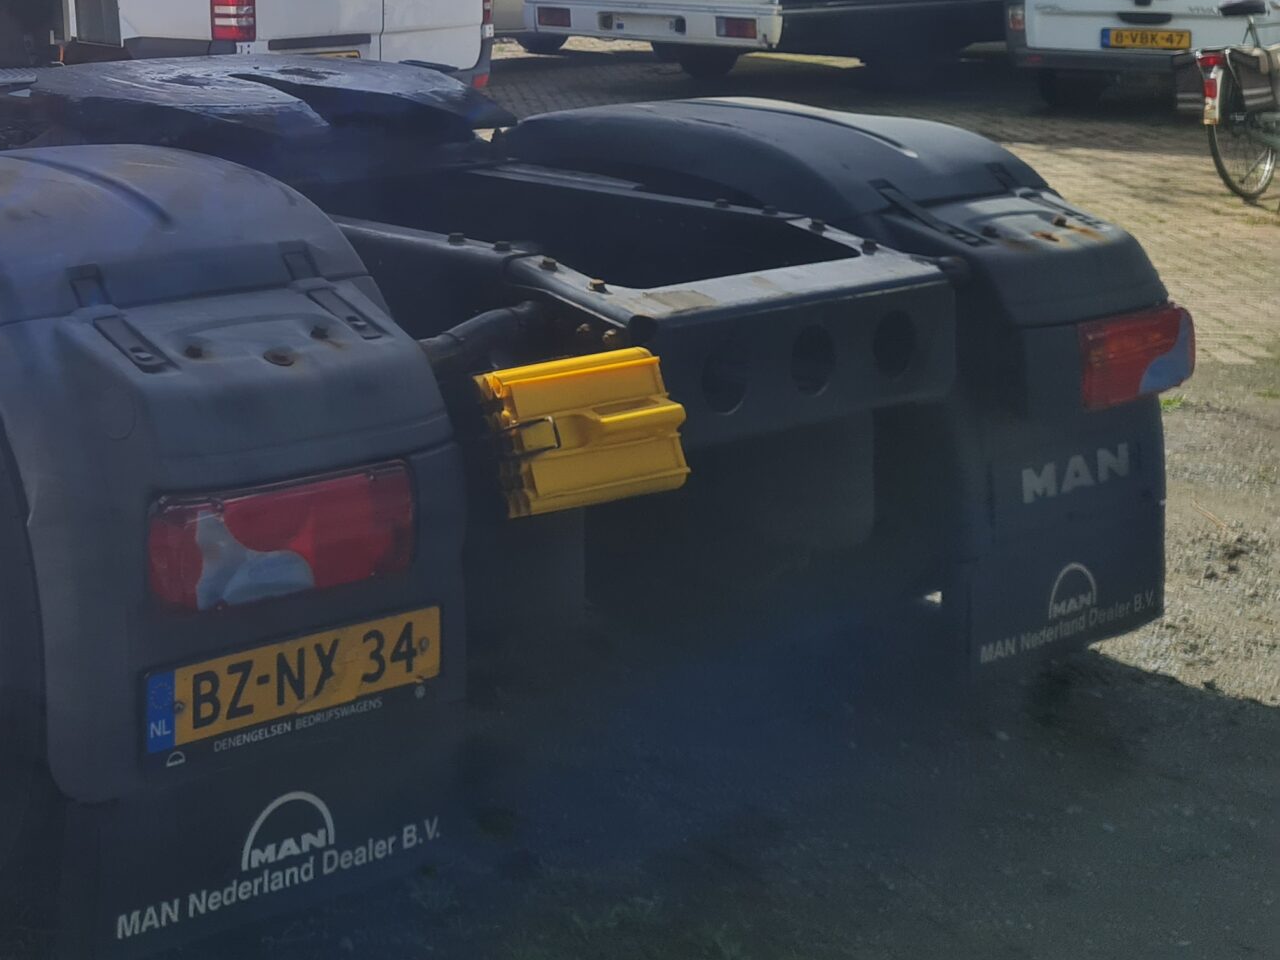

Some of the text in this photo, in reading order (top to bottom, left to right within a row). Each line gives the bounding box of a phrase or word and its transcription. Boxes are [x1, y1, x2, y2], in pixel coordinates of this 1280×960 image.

[1022, 443, 1129, 504] MAN
[980, 589, 1155, 664] MAN Nederland Dealer B.V.
[1053, 592, 1092, 617] MAN
[149, 720, 171, 738] NL
[250, 829, 326, 869] MAN
[117, 816, 441, 940] MAN Nederland Dealer B.V.
